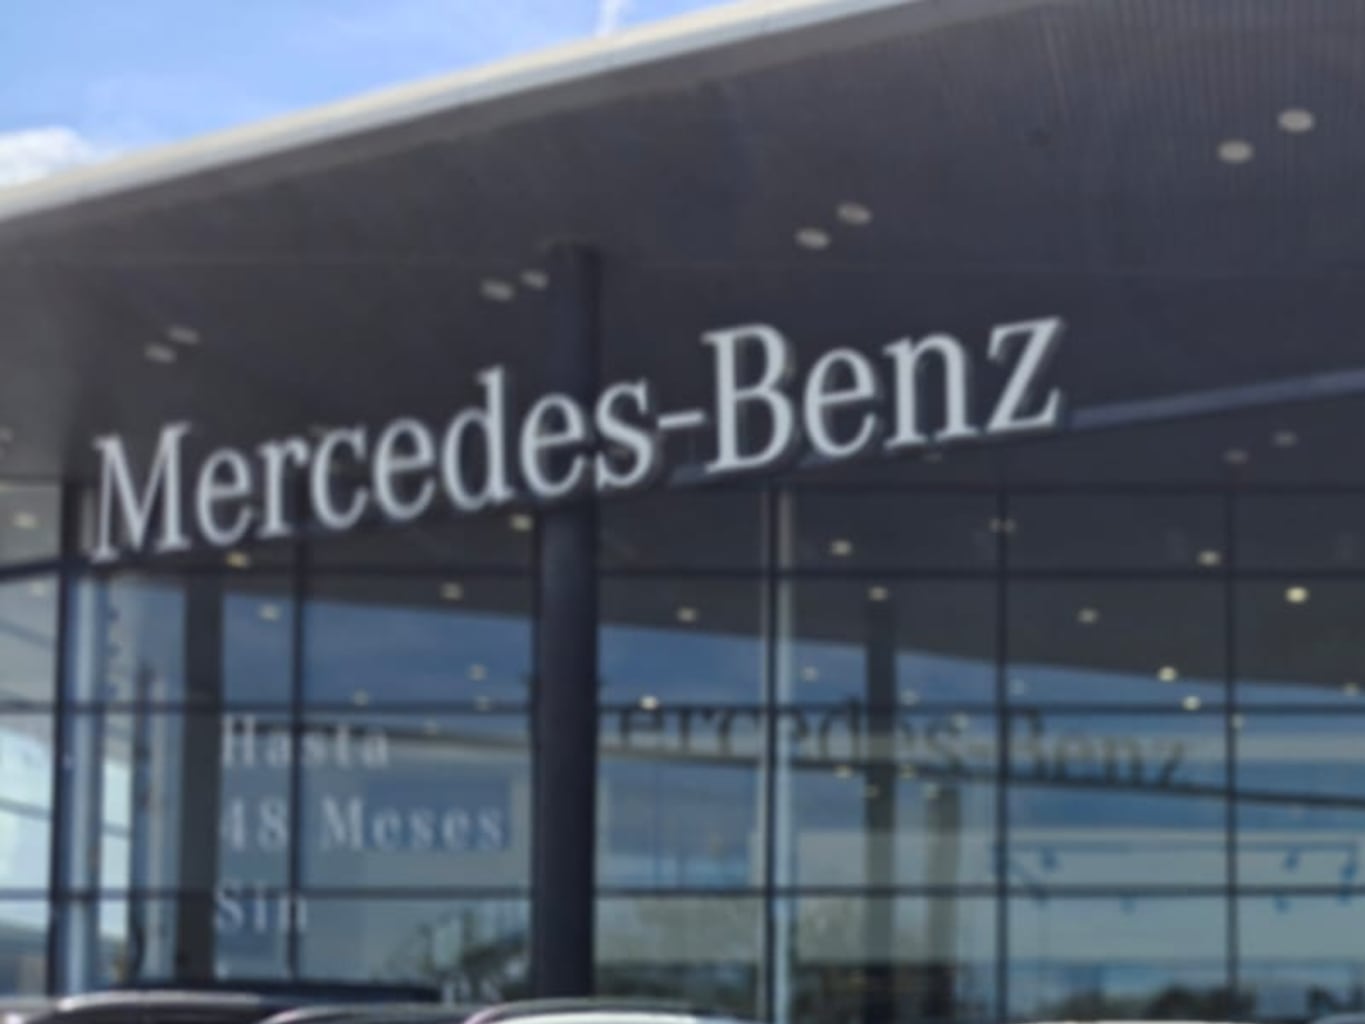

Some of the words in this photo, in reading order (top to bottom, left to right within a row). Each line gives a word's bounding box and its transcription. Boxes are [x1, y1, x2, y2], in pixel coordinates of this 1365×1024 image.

[90, 316, 1063, 562] Mercedes-Benz
[222, 714, 390, 768] Hasta
[220, 796, 288, 852] 48
[322, 796, 507, 852] Meses
